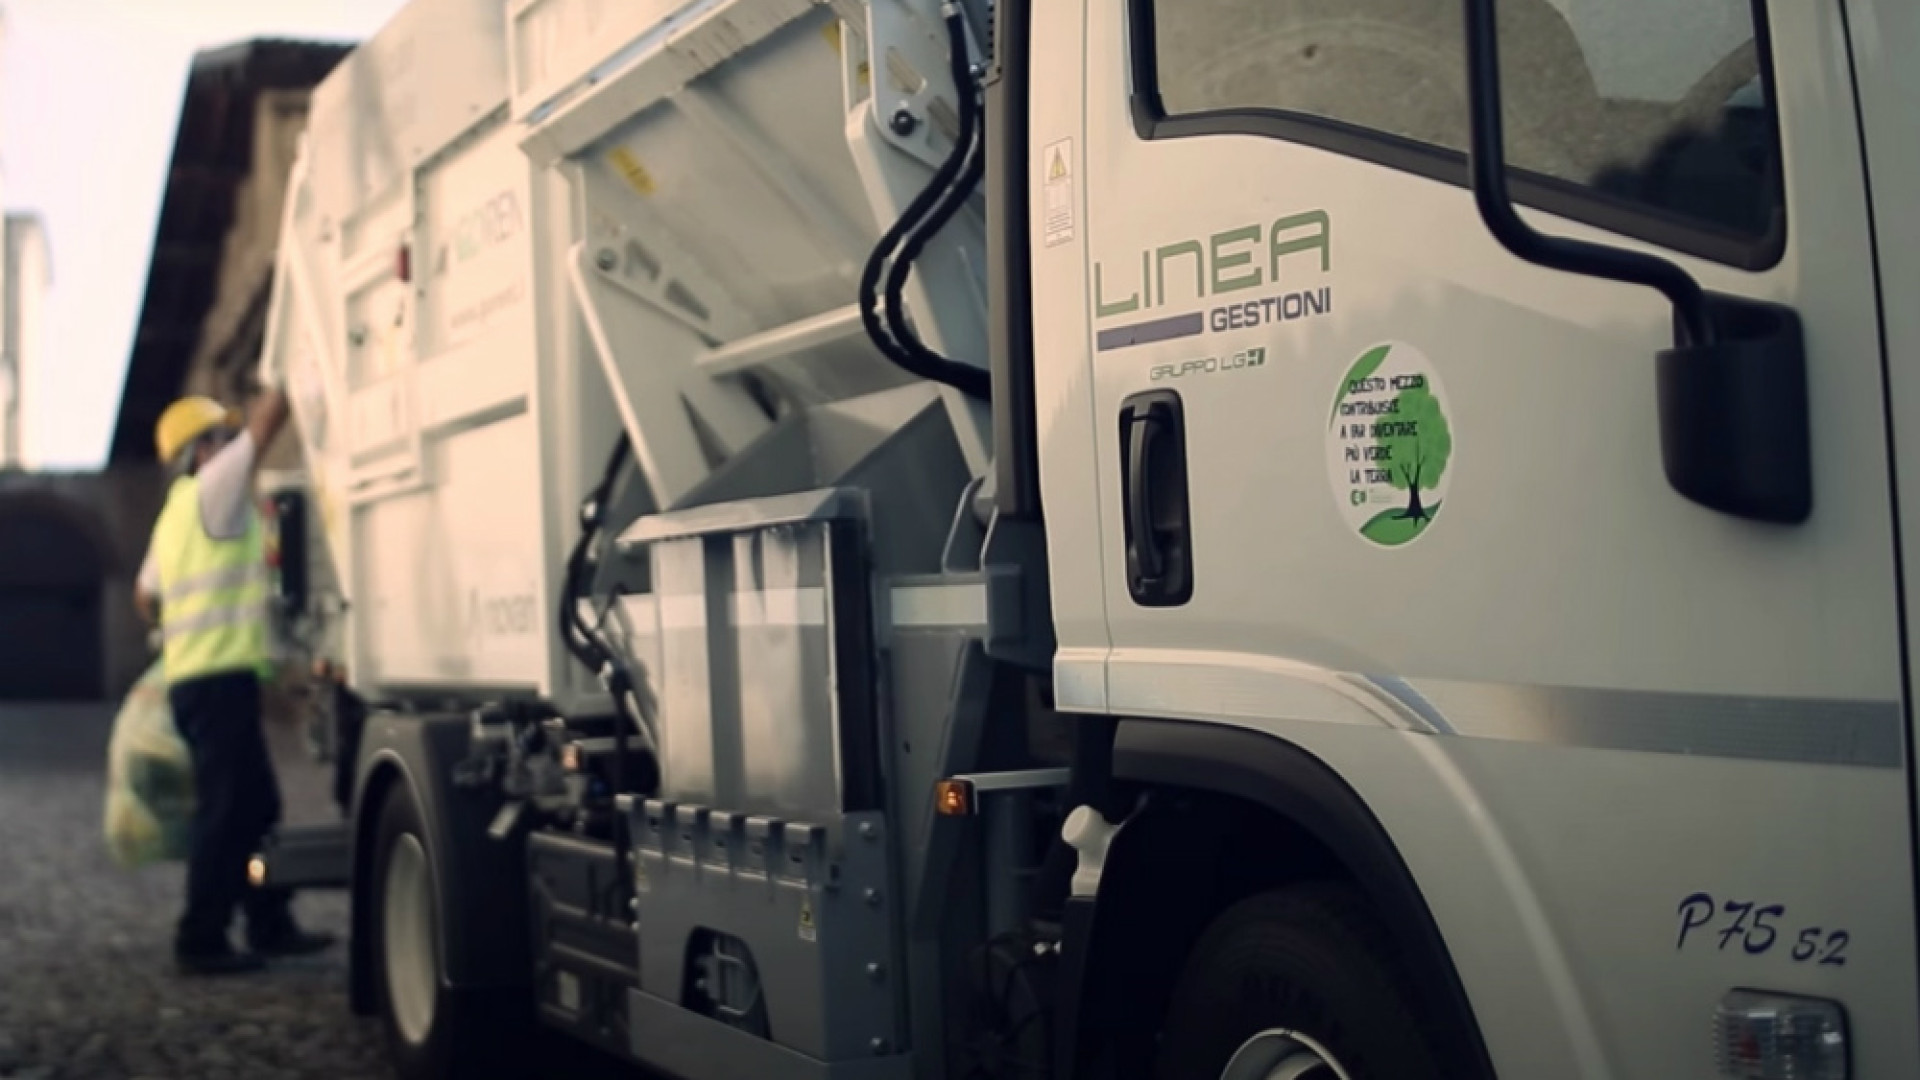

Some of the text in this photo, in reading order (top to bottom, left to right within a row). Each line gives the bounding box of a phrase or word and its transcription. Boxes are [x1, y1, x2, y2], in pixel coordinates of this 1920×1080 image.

[1210, 286, 1332, 333] GESTIONI
[1150, 357, 1217, 381] GRUPPO
[1348, 374, 1424, 394] QUESTO MEZZO
[1340, 423, 1347, 438] A
[1370, 420, 1417, 437] DIVENTARE
[1363, 444, 1393, 462] VERDE
[1350, 467, 1393, 484] LA TERRA
